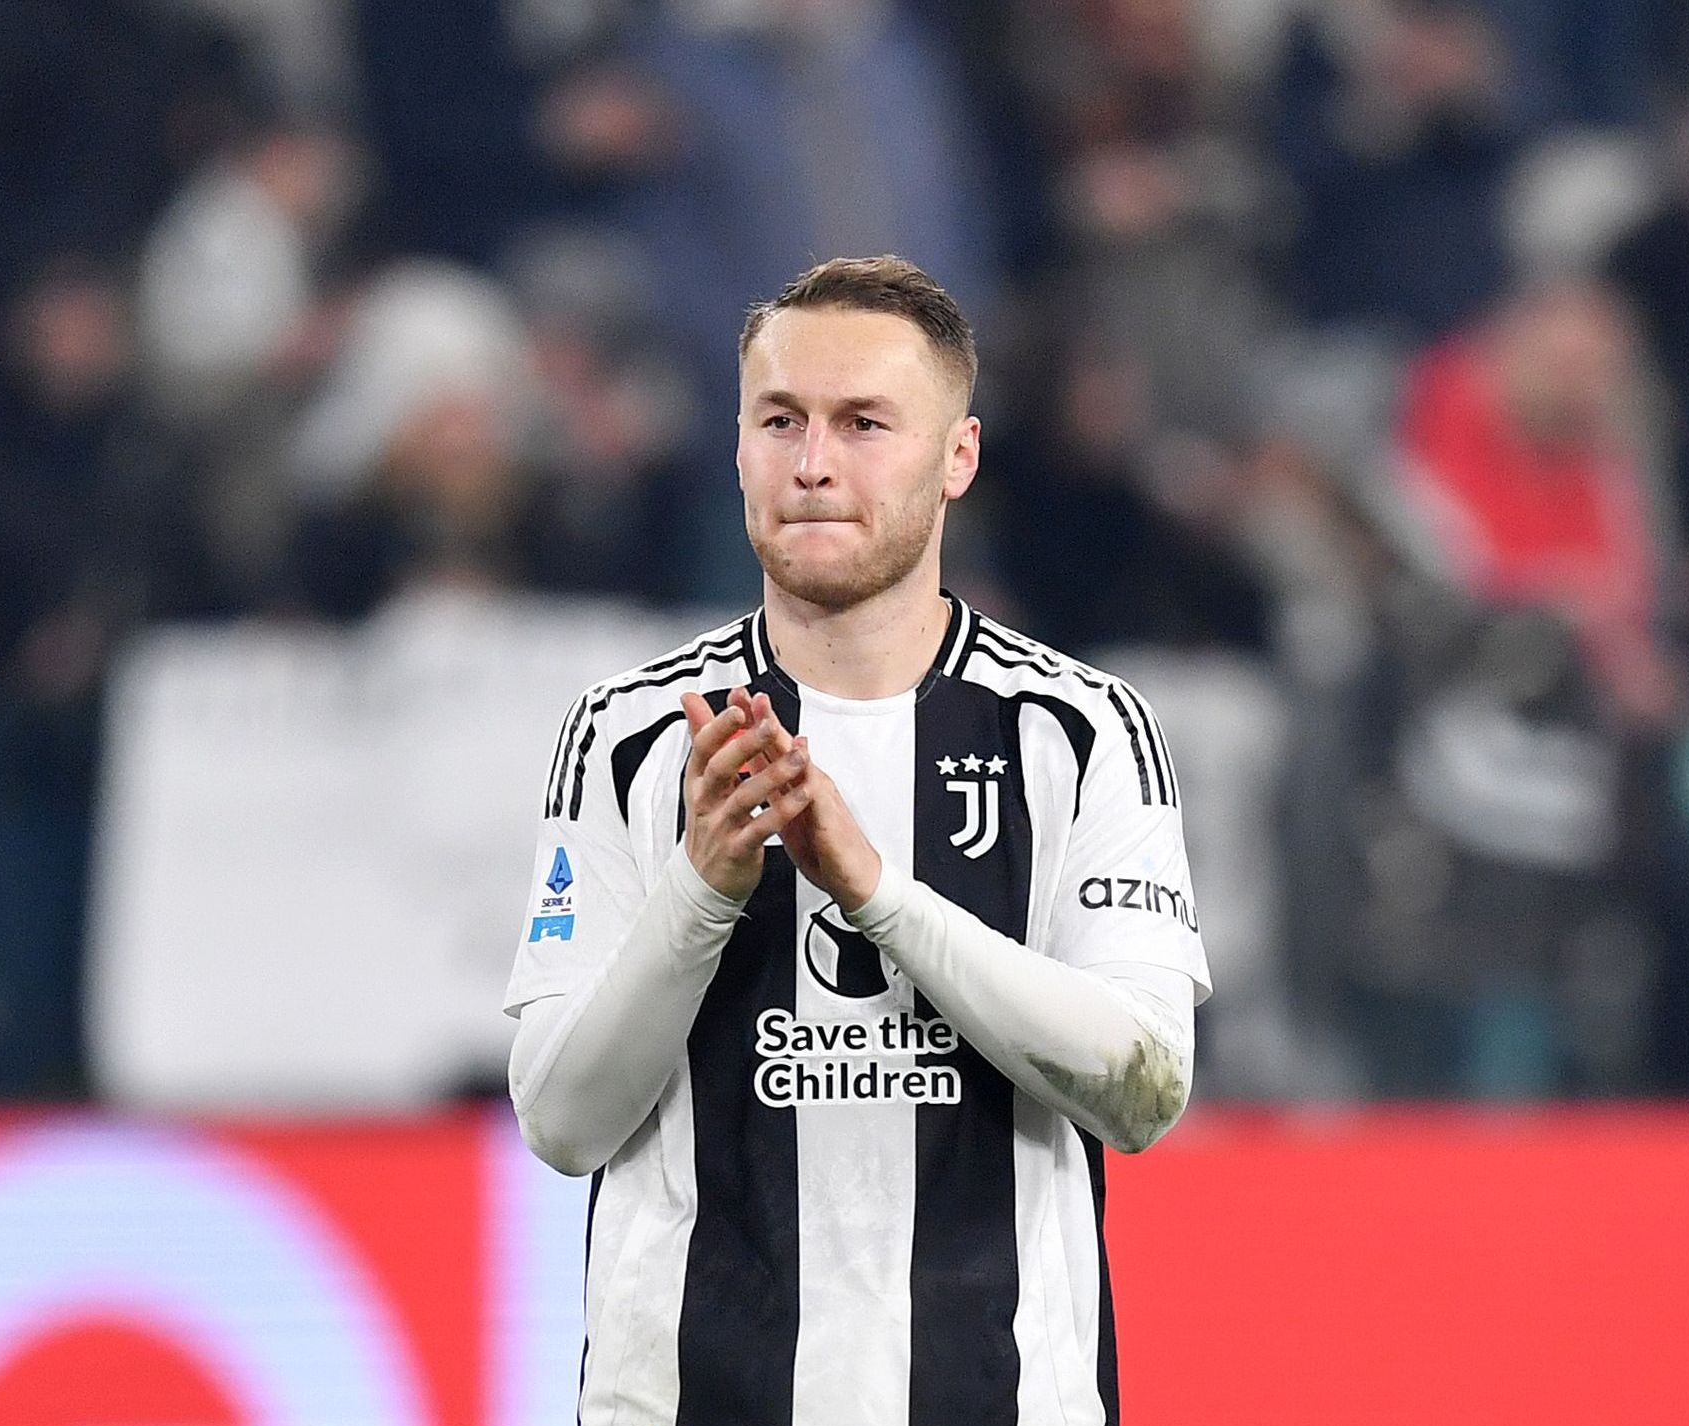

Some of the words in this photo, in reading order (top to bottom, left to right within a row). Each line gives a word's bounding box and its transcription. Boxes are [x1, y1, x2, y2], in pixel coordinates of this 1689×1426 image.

[541, 897, 565, 907] SERIE
[763, 1014, 867, 1051] Save
[879, 1012, 953, 1050] the
[761, 1062, 955, 1100] Children
